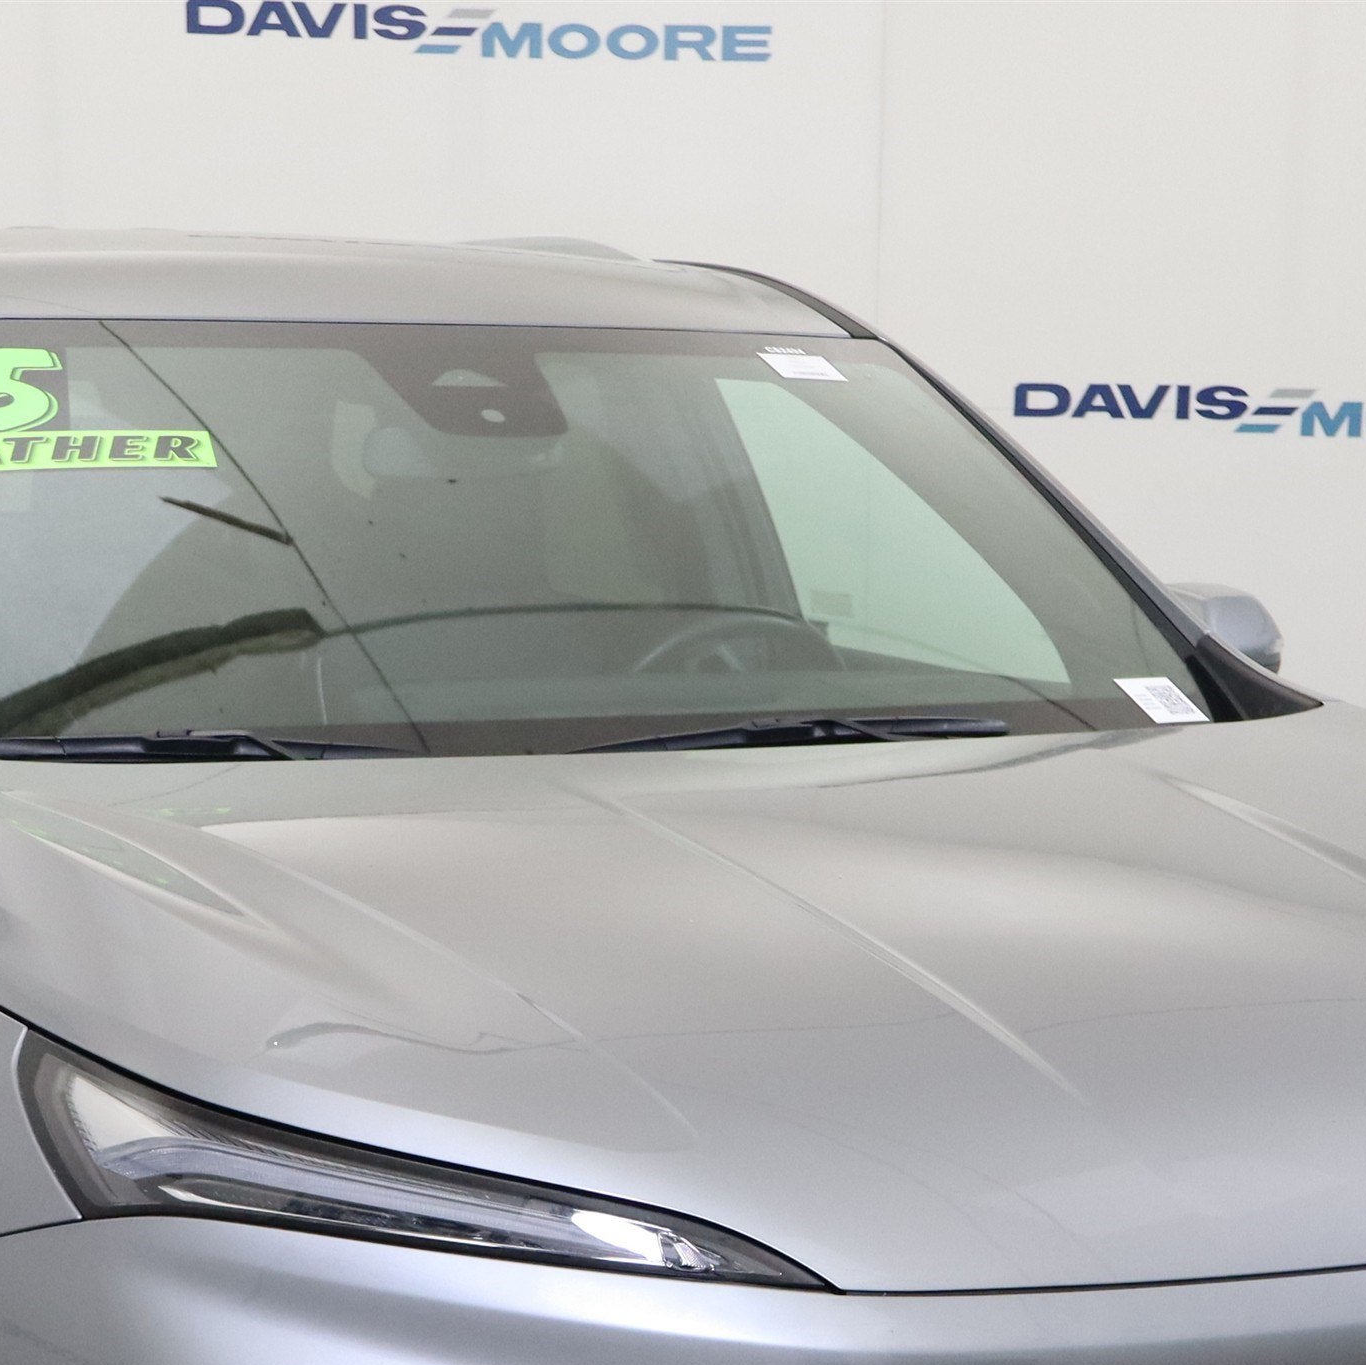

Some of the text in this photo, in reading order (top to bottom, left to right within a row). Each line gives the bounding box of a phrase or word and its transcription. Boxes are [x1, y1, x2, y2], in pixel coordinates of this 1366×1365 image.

[186, 0, 773, 62] DAVIS MOORE
[1013, 382, 1249, 421] DAVIS
